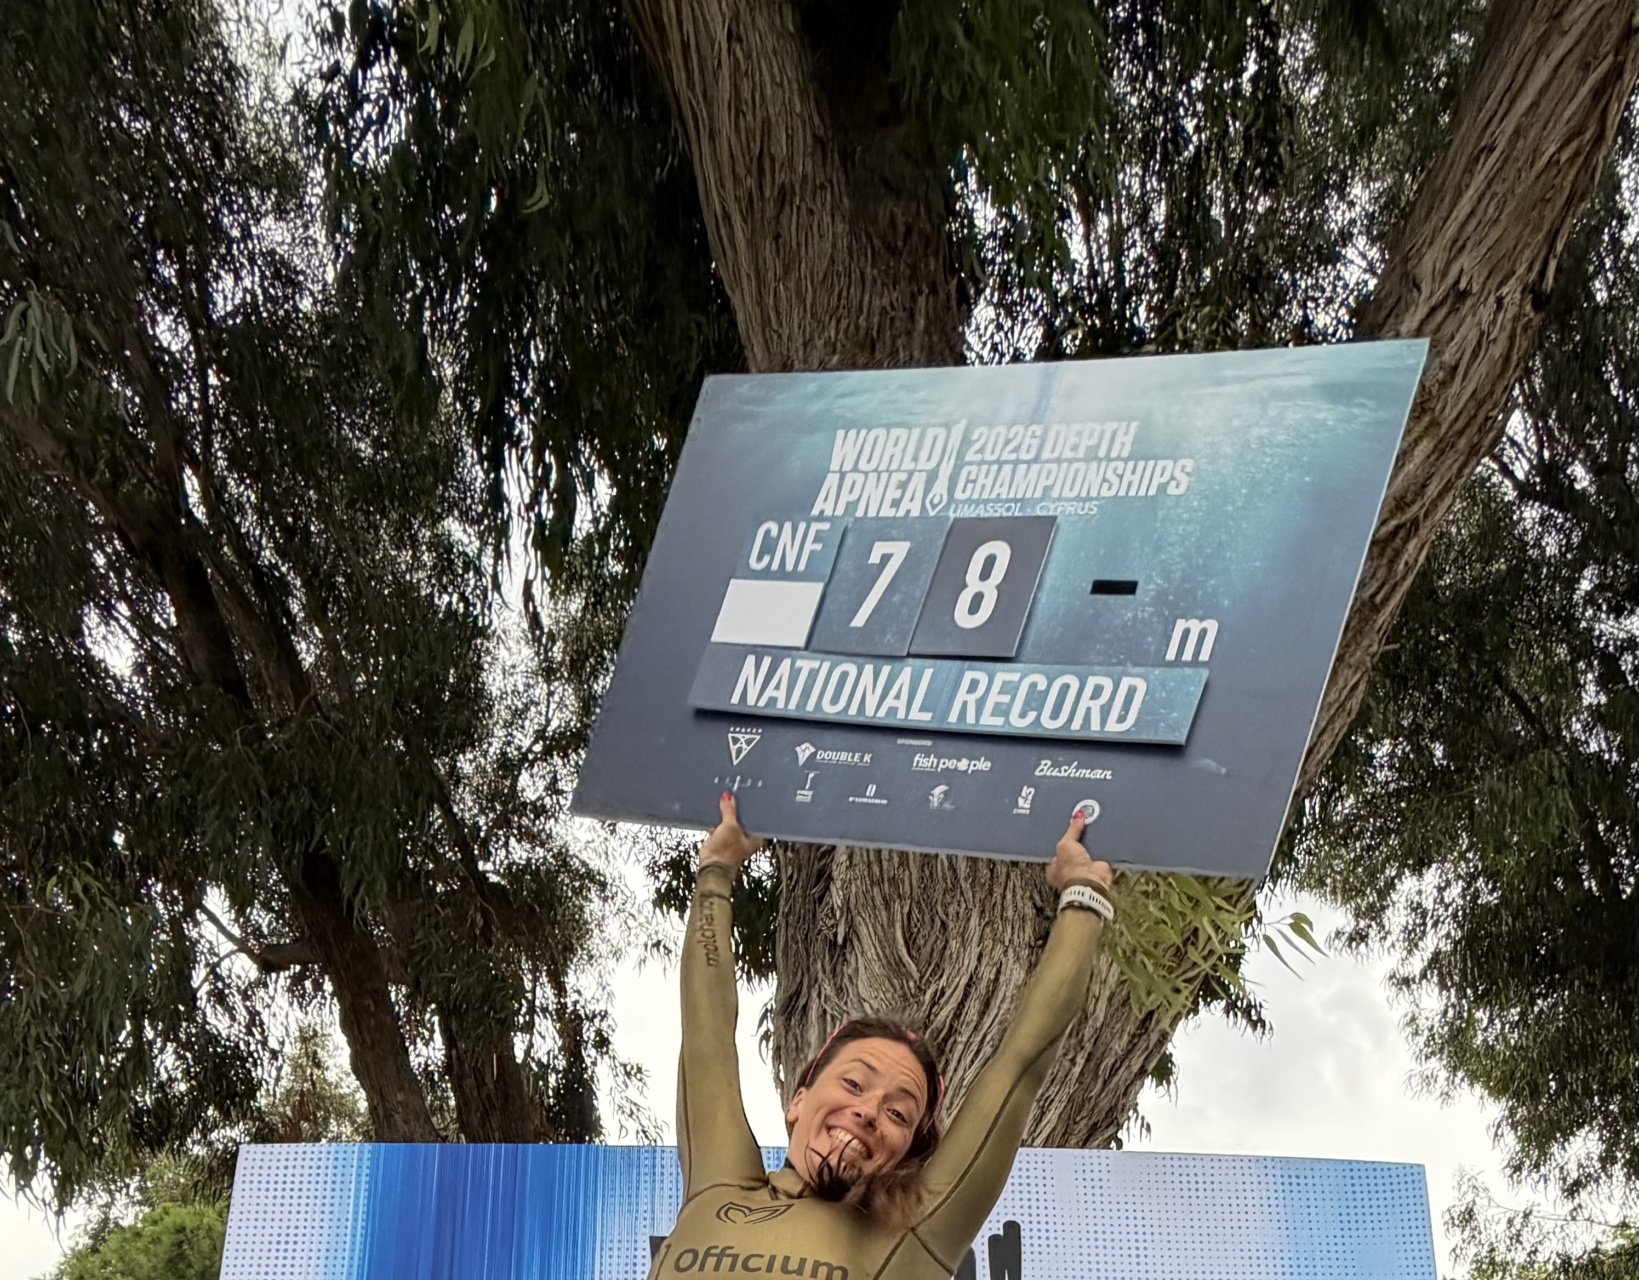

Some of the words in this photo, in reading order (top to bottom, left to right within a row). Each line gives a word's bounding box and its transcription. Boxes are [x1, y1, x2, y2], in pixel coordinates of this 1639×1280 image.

[829, 427, 946, 472] WORLD
[964, 426, 1040, 461] 2026
[1041, 421, 1139, 460] DEPTH
[809, 471, 926, 518] APNEA
[953, 459, 1195, 500] CHAMPIONSHIPS
[949, 502, 1023, 518] LIMASSOL
[1034, 501, 1099, 516] CYPRUS
[748, 521, 831, 573] CNF
[1165, 617, 1219, 662] m
[730, 653, 934, 722] NATIONAL
[947, 670, 1147, 732] RECORD
[816, 750, 861, 763] DOUBLE
[1034, 759, 1113, 780] Bushman
